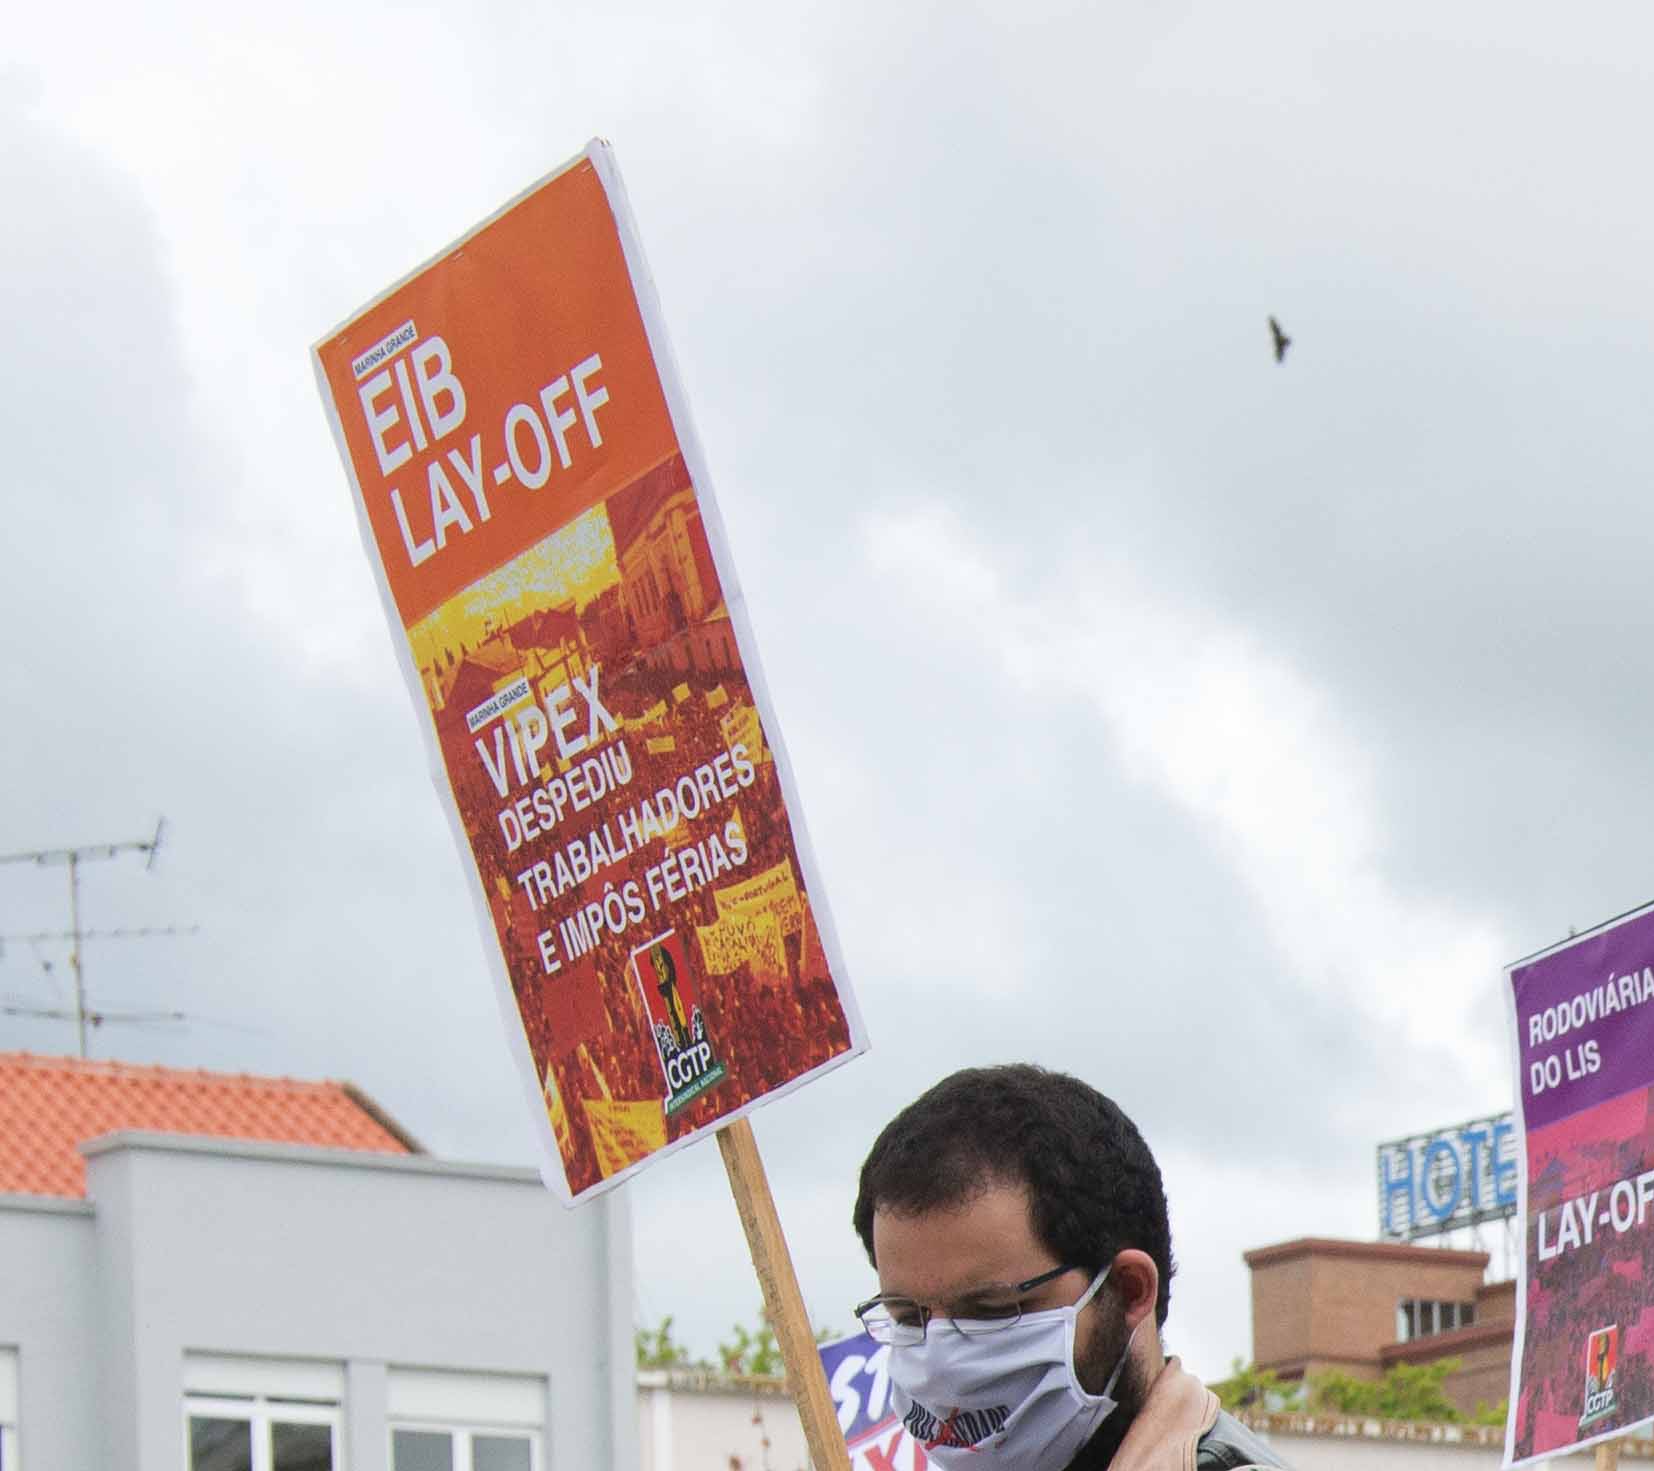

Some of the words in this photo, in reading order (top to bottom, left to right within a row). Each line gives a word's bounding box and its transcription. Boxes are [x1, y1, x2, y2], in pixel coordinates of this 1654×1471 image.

[354, 346, 386, 376] MARINHA
[385, 326, 416, 358] GRANDE
[358, 335, 466, 478] EIB
[390, 353, 610, 568] LAY-OFF
[469, 702, 500, 730] MARINHA
[499, 682, 530, 713] GRANDE
[475, 662, 620, 798] VIPEX
[498, 740, 633, 851] DESPEDIU
[517, 743, 755, 911] TRABALHADORES
[537, 930, 561, 974] E
[559, 882, 646, 961] IMPÔS
[645, 821, 748, 911] FÉRIAS
[668, 1041, 711, 1089] CGTP
[1530, 1054, 1561, 1095] DO
[1565, 1040, 1601, 1080] LIS
[1383, 1122, 1516, 1230] HOTE
